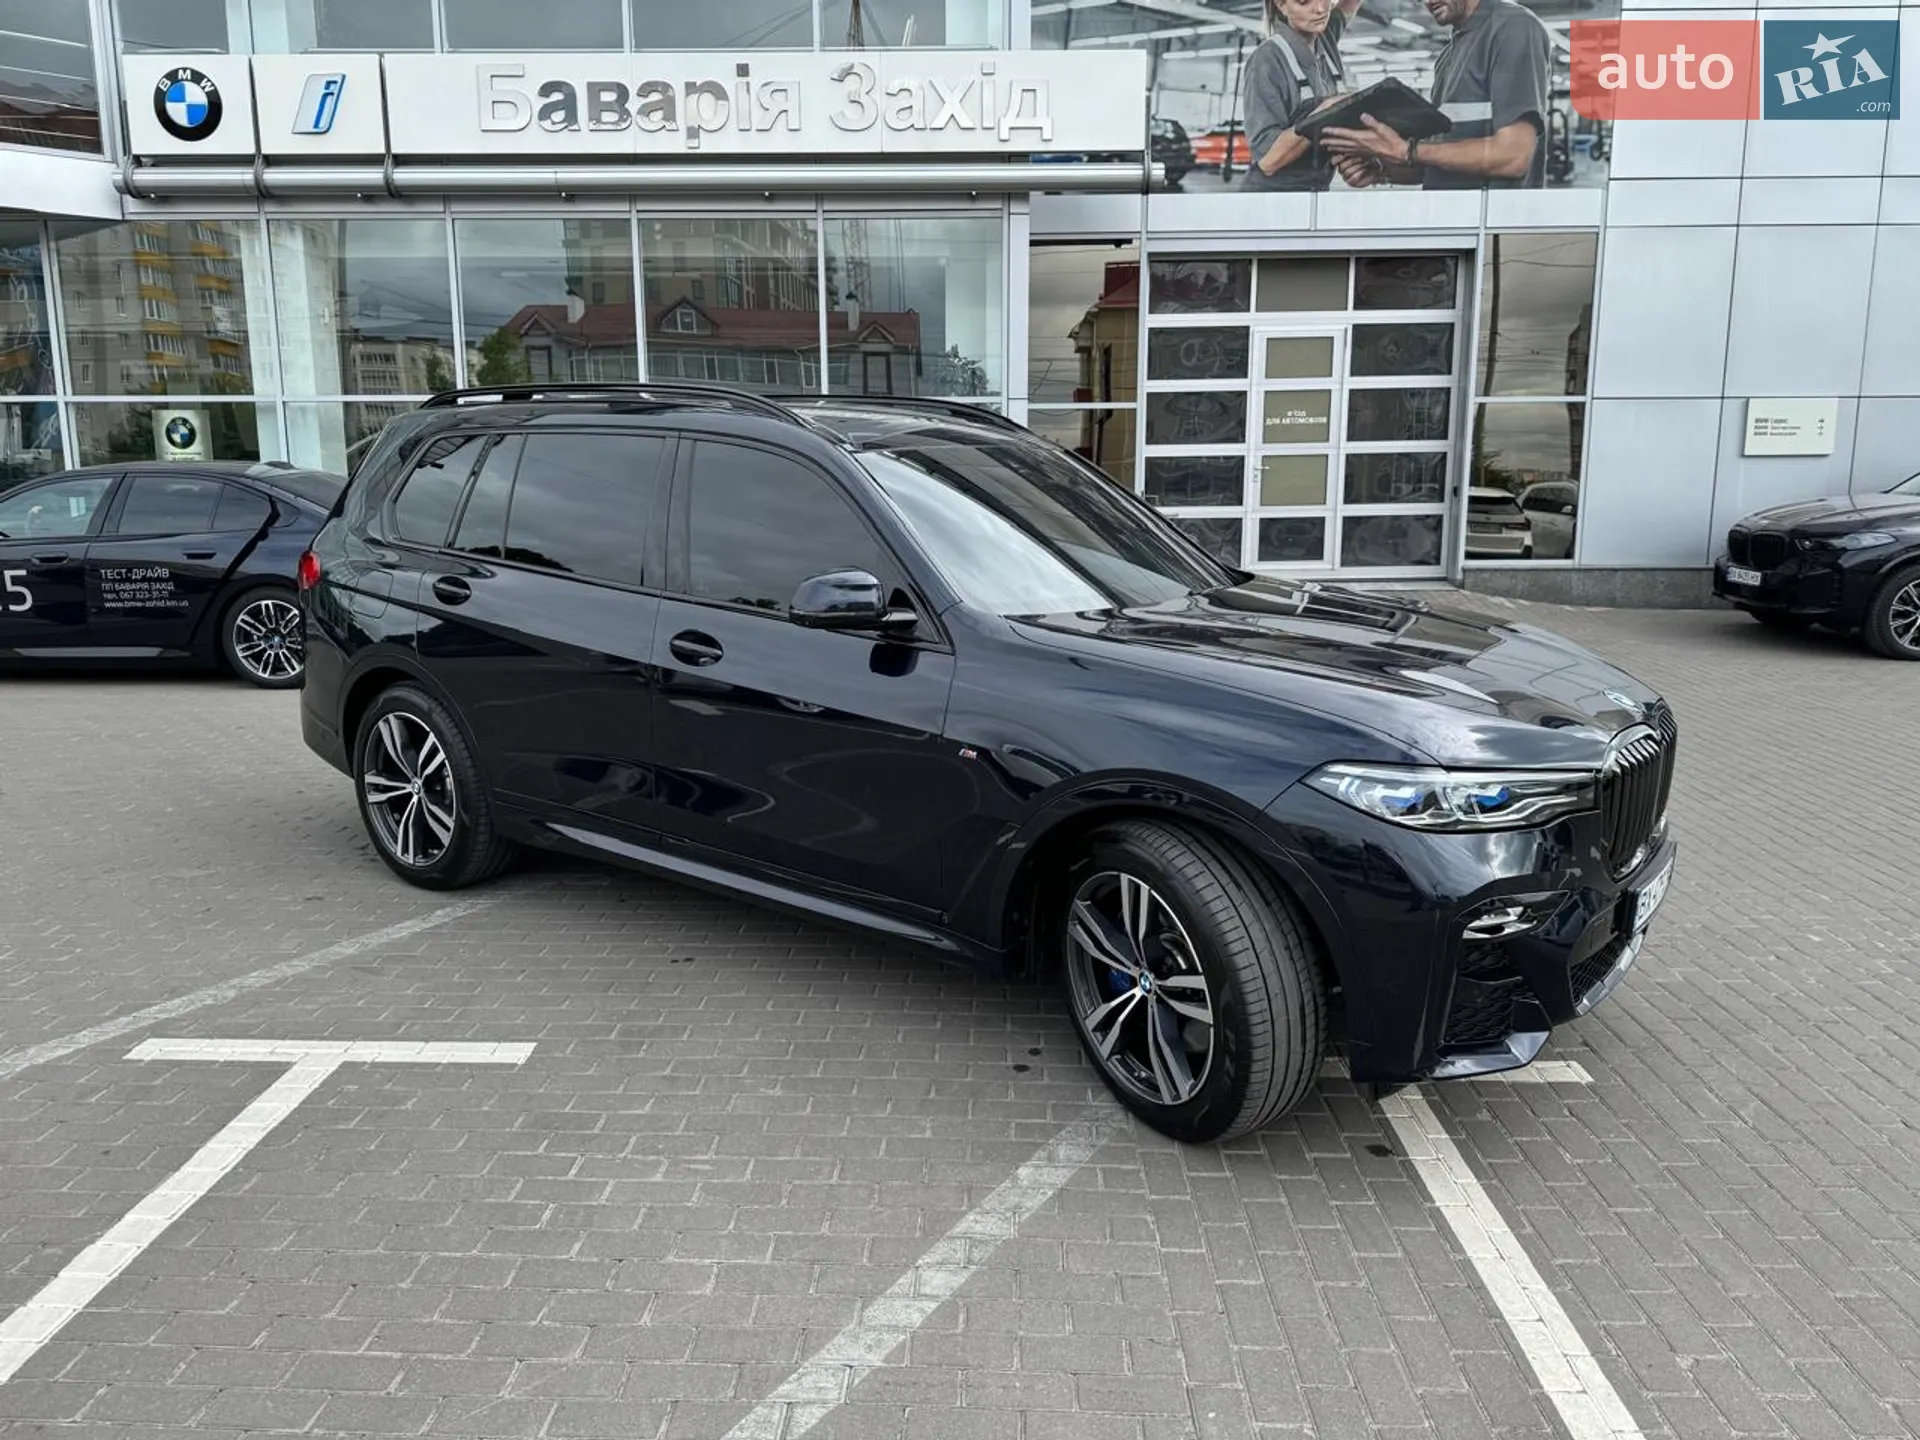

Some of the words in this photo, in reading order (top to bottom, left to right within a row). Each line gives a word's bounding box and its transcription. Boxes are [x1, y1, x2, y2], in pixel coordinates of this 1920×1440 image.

[158, 69, 214, 92] BMW
[476, 63, 802, 149] Баварія
[830, 60, 1053, 141] Захід
[101, 567, 169, 579] ТЕСТ-ДРАЙВ
[0, 569, 33, 611] 5
[114, 582, 150, 591] БАВАРІЯ
[150, 581, 175, 590] ЗАХІД
